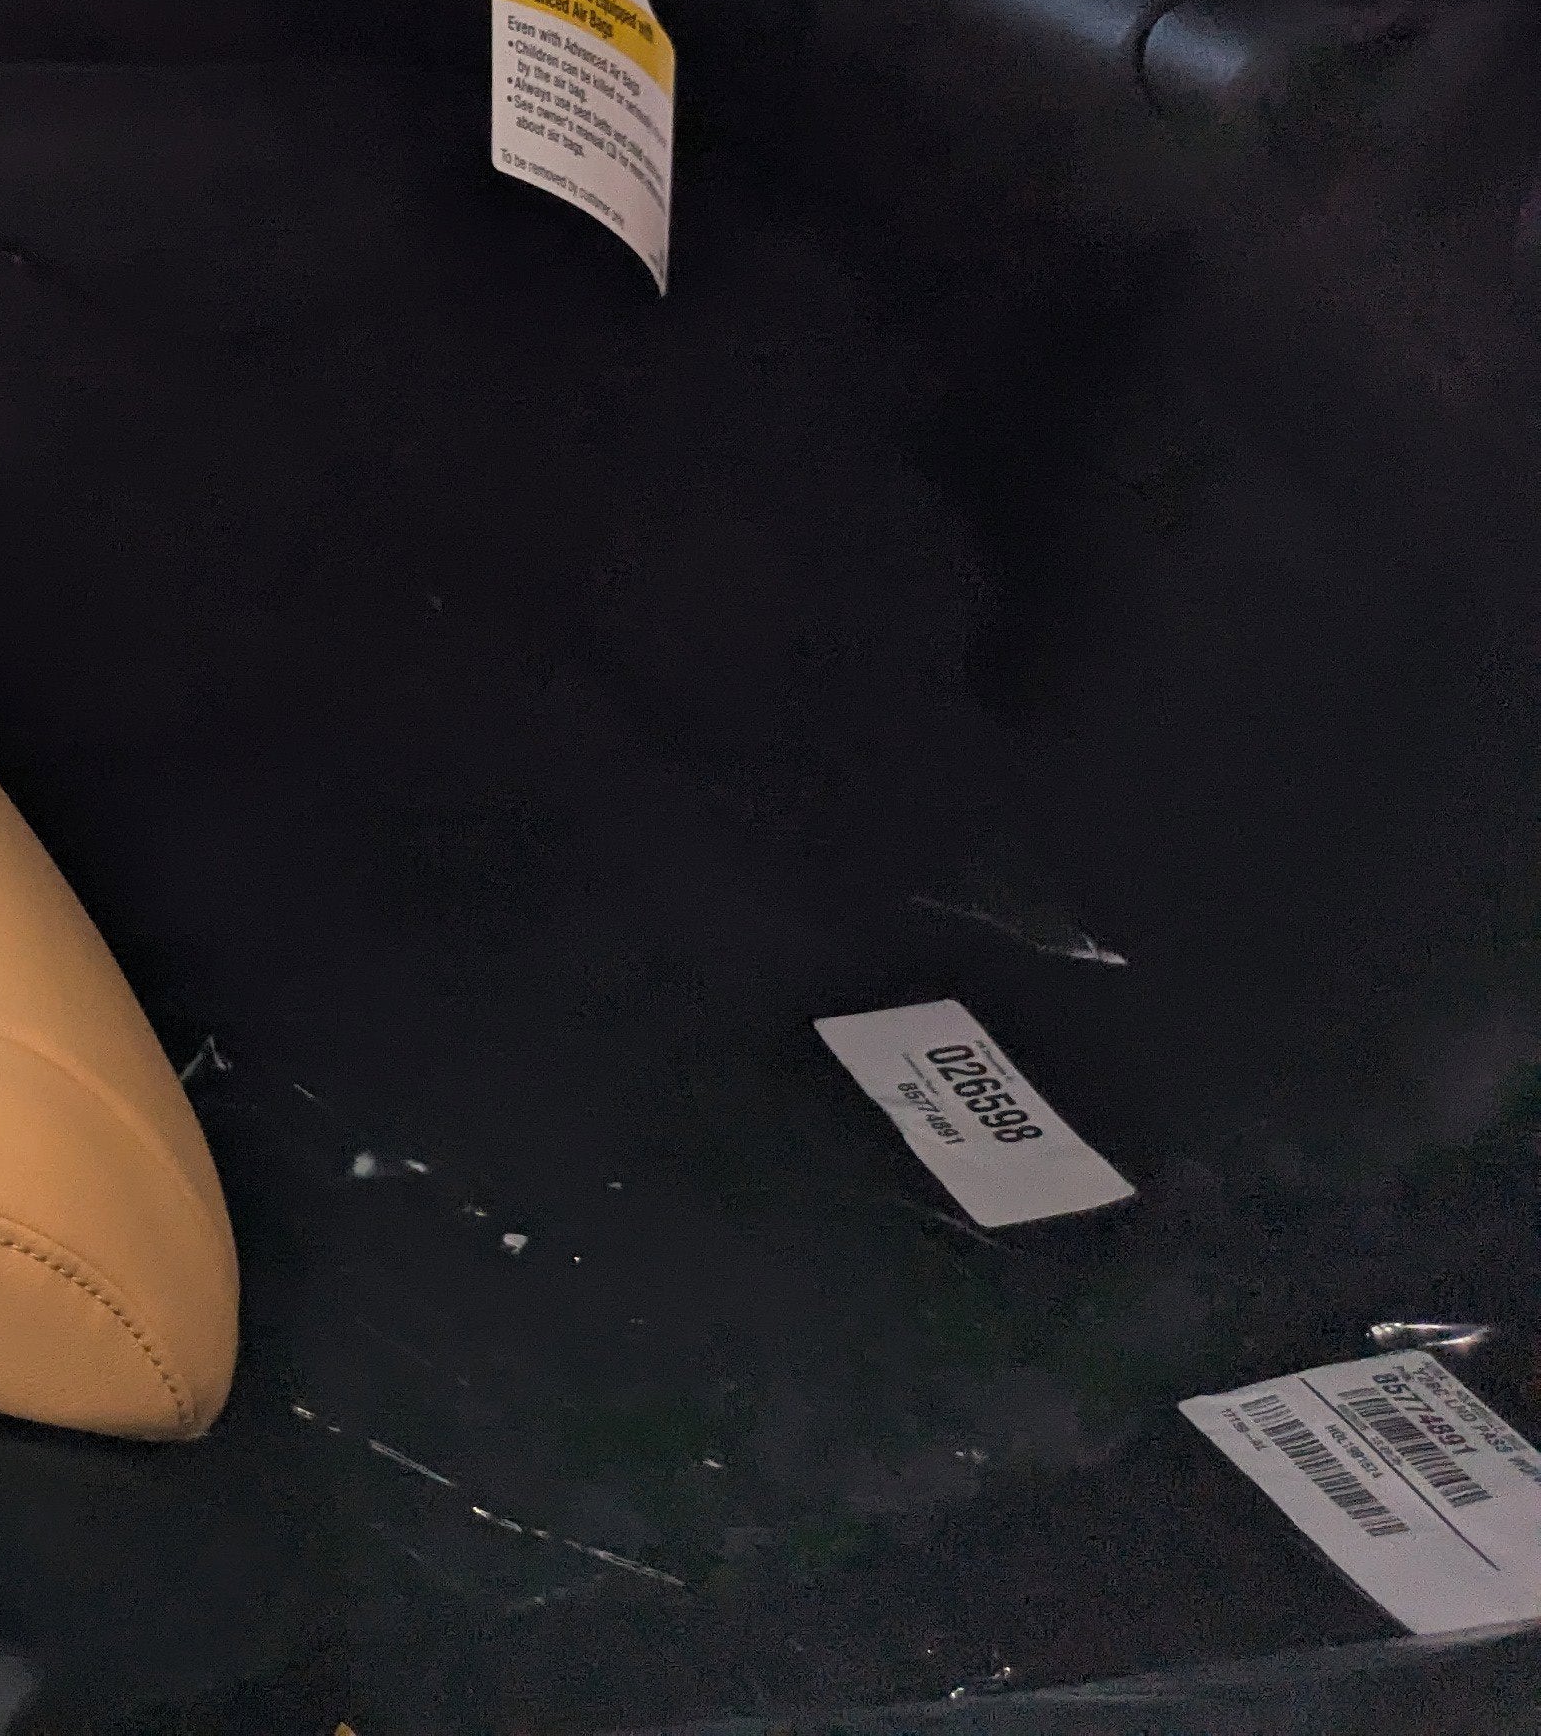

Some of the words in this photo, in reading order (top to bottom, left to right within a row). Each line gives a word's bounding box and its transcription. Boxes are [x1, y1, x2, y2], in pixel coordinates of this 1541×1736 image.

[572, 1, 588, 23] Air
[589, 10, 614, 39] Bags
[507, 15, 536, 38] Even
[538, 28, 562, 48] with
[564, 37, 607, 73] Advanced
[515, 39, 559, 69] Children
[561, 60, 579, 78] can
[580, 67, 591, 85] be
[517, 58, 531, 78] by
[534, 65, 551, 84] the
[554, 75, 567, 90] air
[514, 76, 552, 103] Always
[554, 95, 571, 112] use
[514, 94, 534, 114] See
[536, 106, 574, 132] owner's
[516, 116, 546, 138] about
[547, 128, 560, 143] air
[499, 146, 513, 165] To
[514, 153, 527, 170] be
[529, 161, 567, 189] removed
[567, 180, 579, 198] by
[924, 1044, 1044, 1143] 026598
